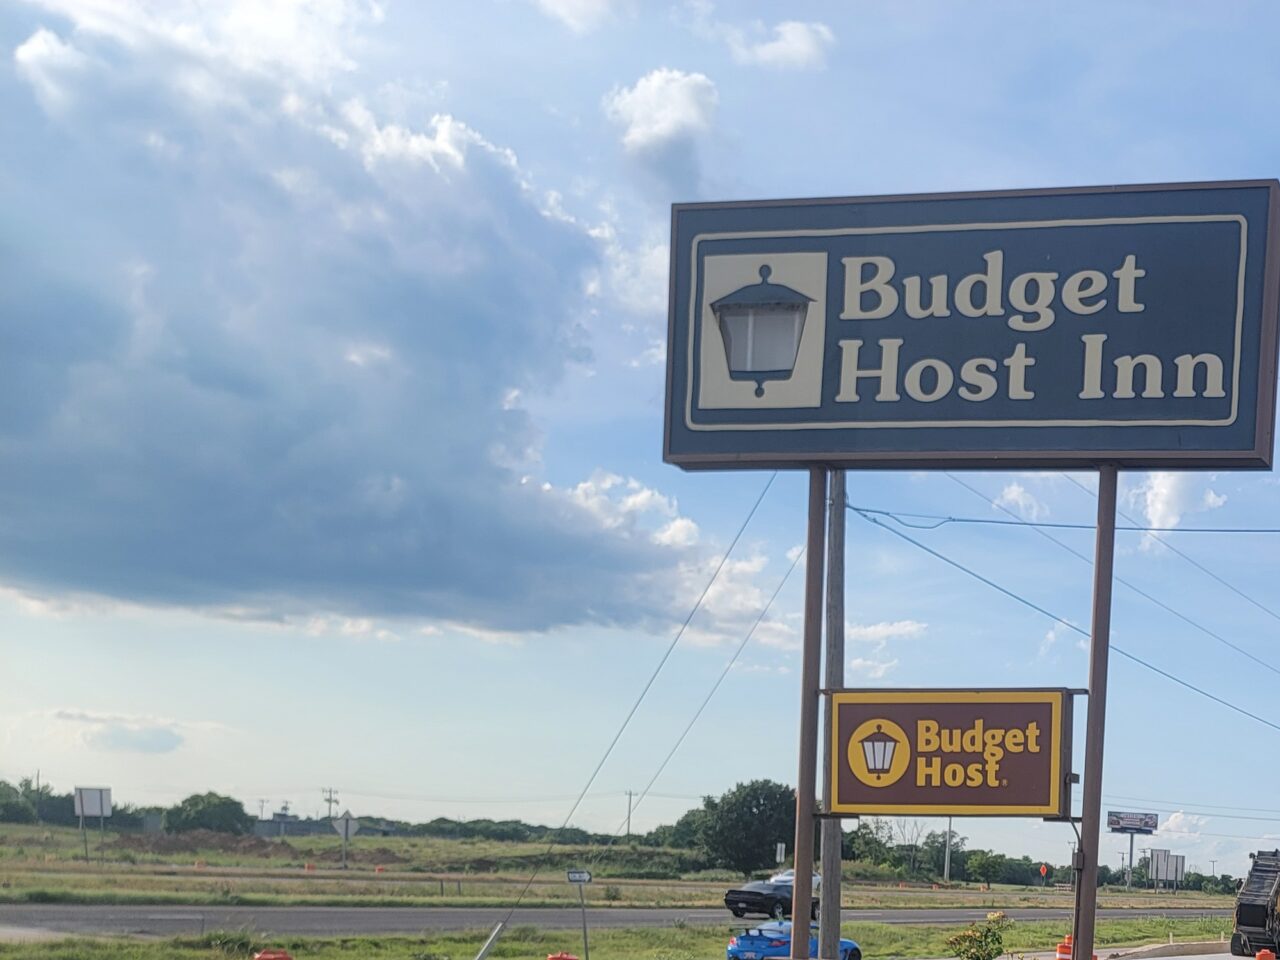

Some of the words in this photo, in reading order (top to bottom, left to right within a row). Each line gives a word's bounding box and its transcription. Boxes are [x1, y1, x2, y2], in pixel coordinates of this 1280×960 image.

[839, 249, 1147, 332] Budget
[835, 337, 1037, 404] Host
[1079, 333, 1227, 400] Inn
[916, 719, 1040, 761] Budget
[915, 757, 1000, 788] Host
